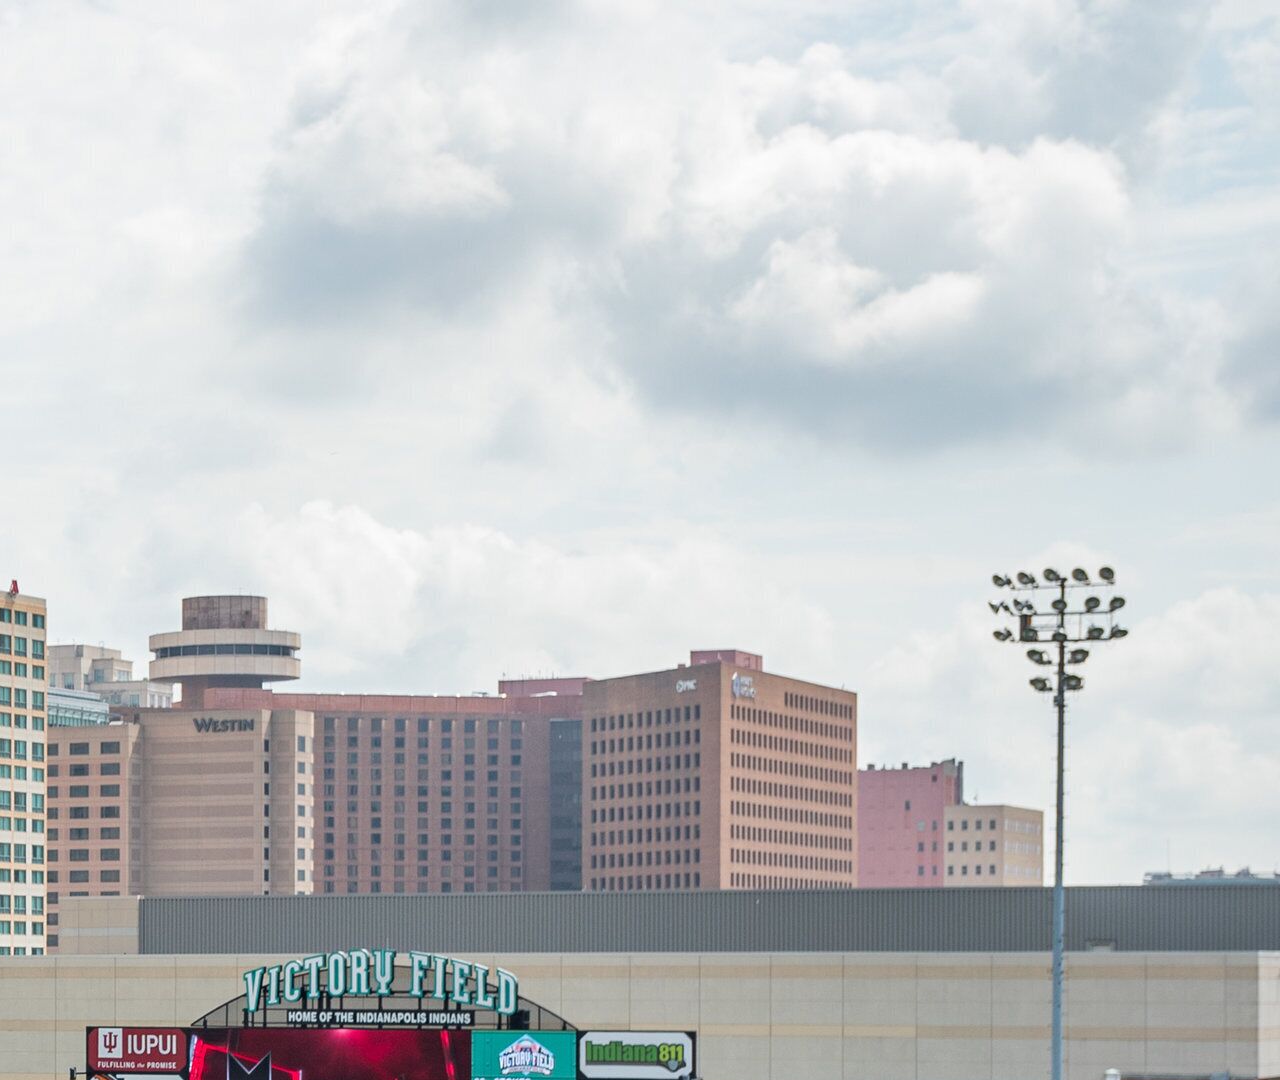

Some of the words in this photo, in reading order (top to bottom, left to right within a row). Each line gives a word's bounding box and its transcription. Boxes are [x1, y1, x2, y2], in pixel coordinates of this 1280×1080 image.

[243, 948, 397, 1012] VICTORY
[409, 950, 519, 1016] FIELD
[288, 1011, 318, 1023] HOME
[319, 1011, 333, 1023] OF
[334, 1011, 354, 1023] THE
[356, 1012, 427, 1024] INDIANAPOLIS
[429, 1012, 471, 1025] INDIANS
[127, 1034, 177, 1055] IUPUI
[97, 1061, 135, 1069] FULFILLING
[146, 1061, 177, 1069] PROMISE
